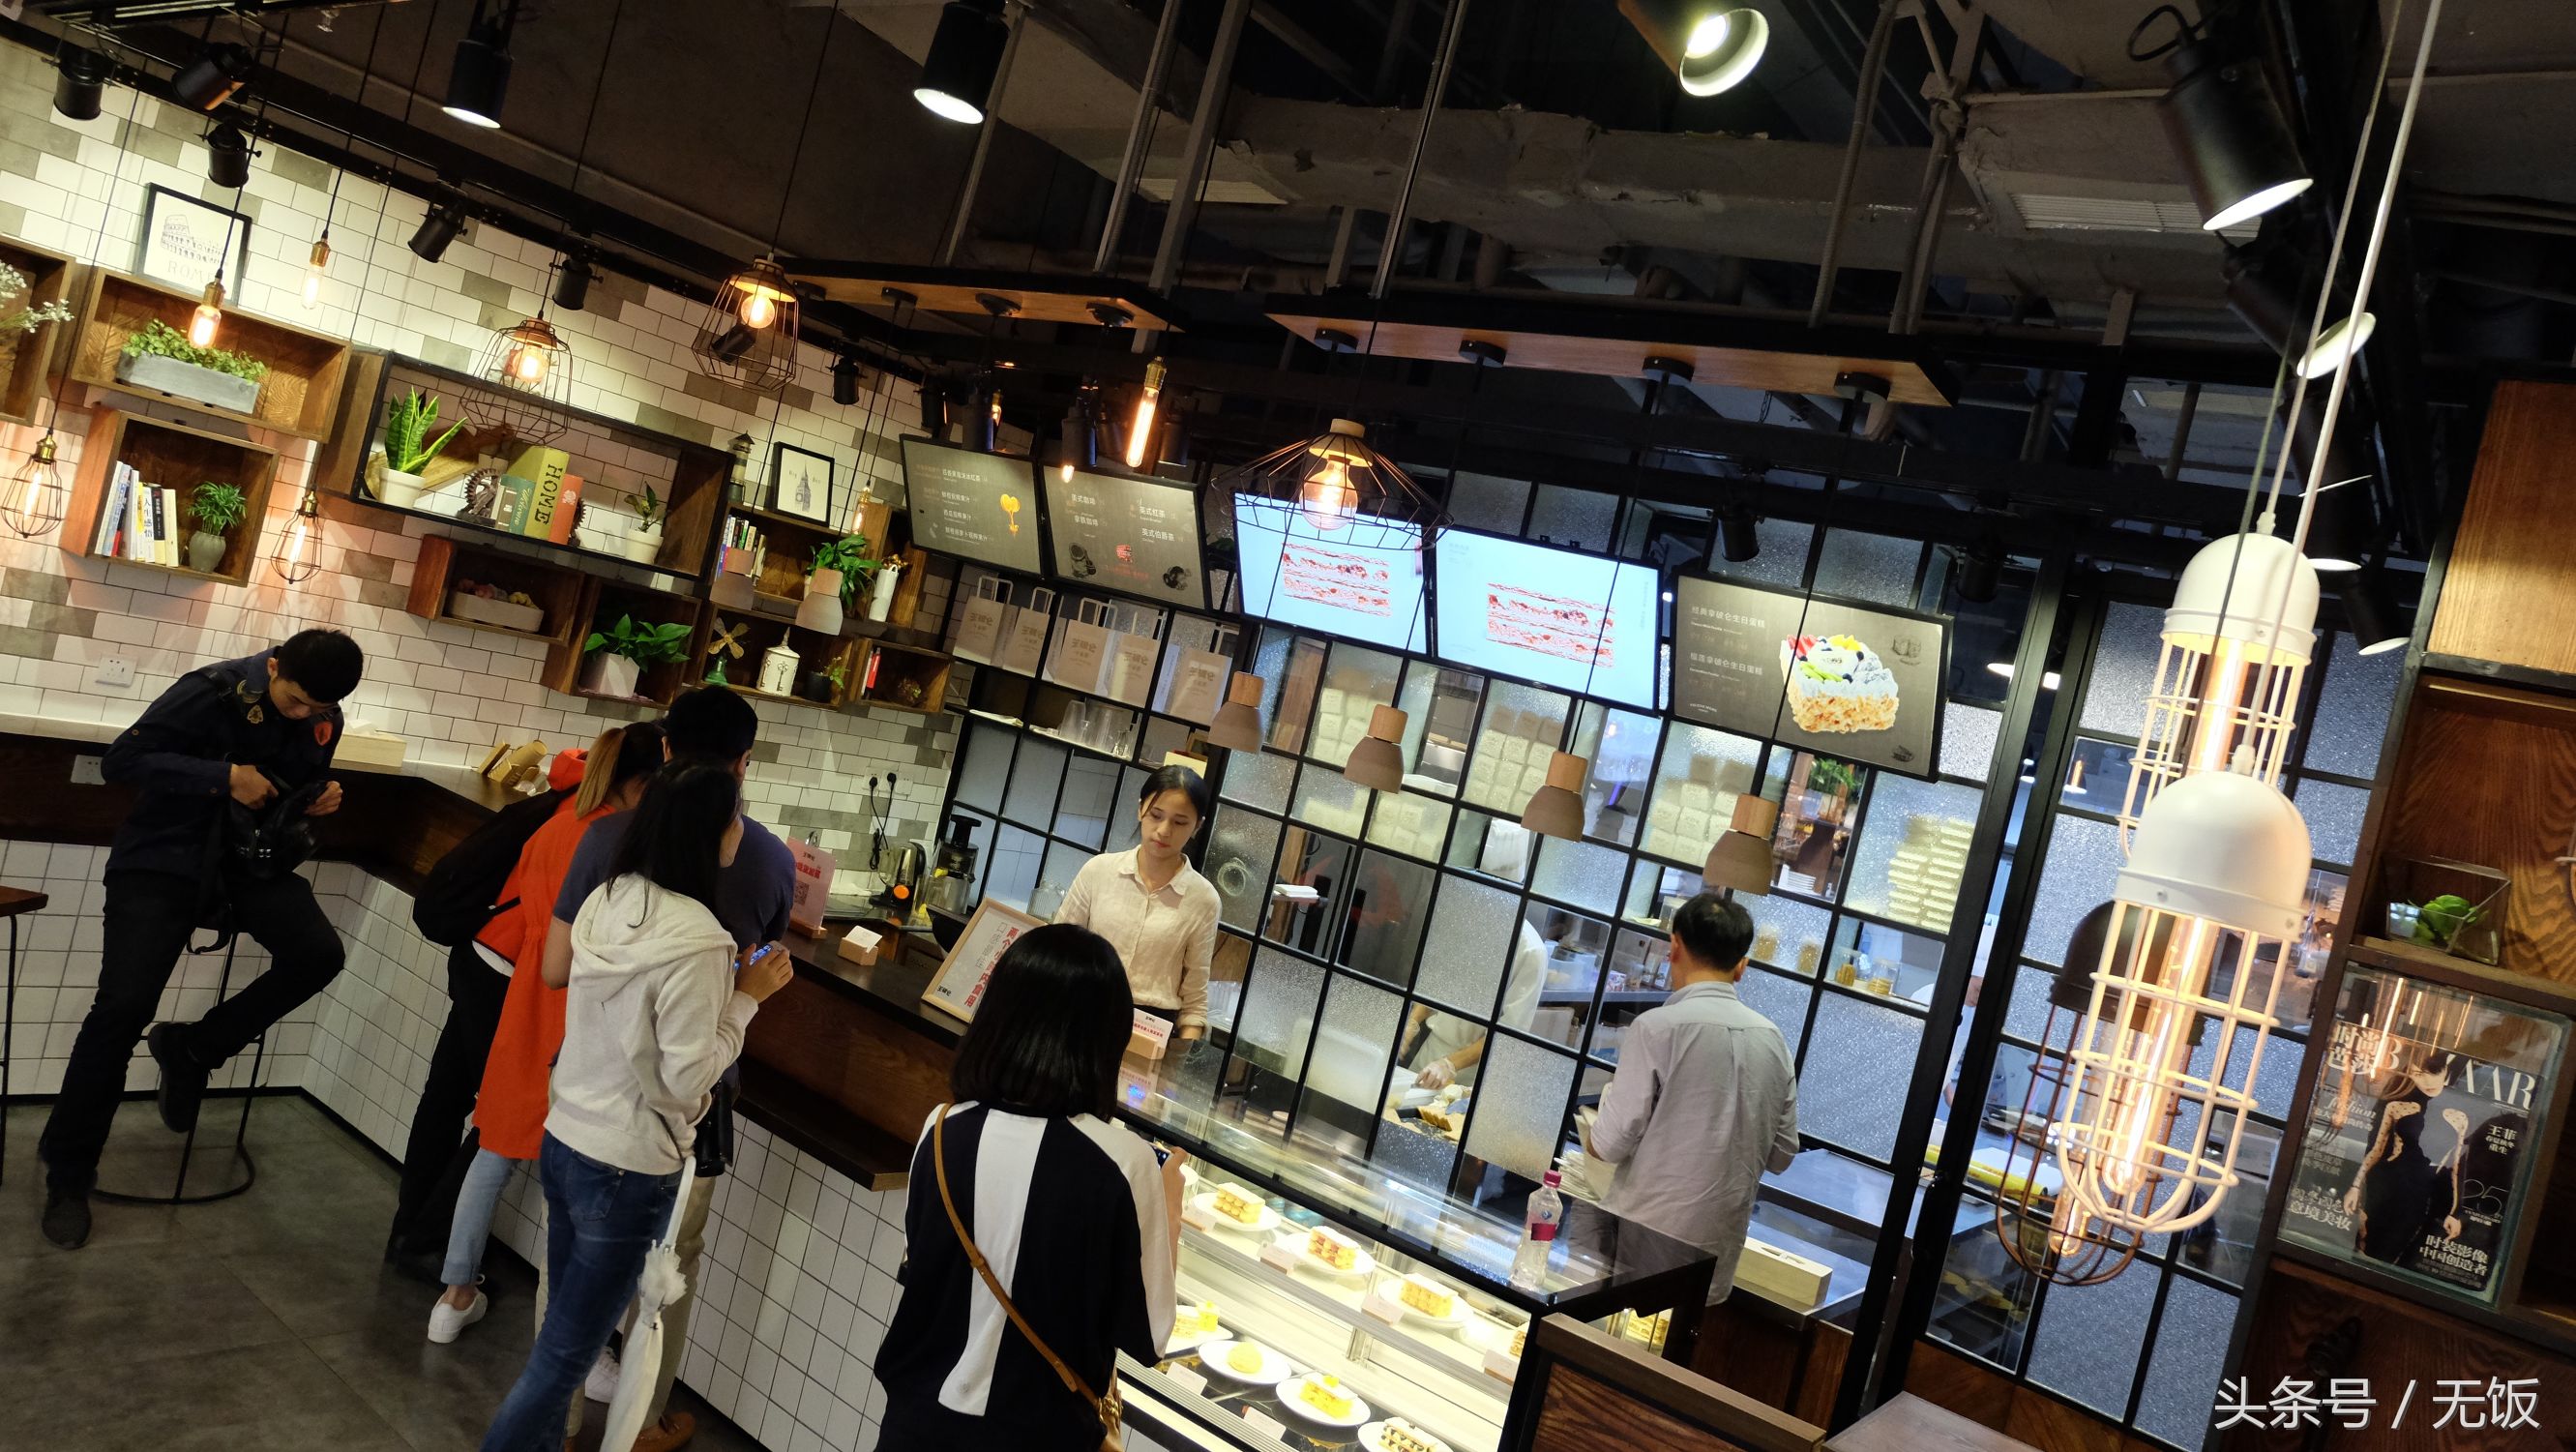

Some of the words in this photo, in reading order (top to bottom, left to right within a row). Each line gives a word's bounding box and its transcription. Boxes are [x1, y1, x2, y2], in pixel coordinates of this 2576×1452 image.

[534, 463, 564, 525] HOME
[1691, 606, 1765, 629] 经典拿破仑生日蛋糕
[2488, 1123, 2517, 1141] 王菲
[2462, 1179, 2509, 1217] 25
[2419, 1246, 2488, 1276] 中国创造者
[2426, 1234, 2489, 1264] 时装影像
